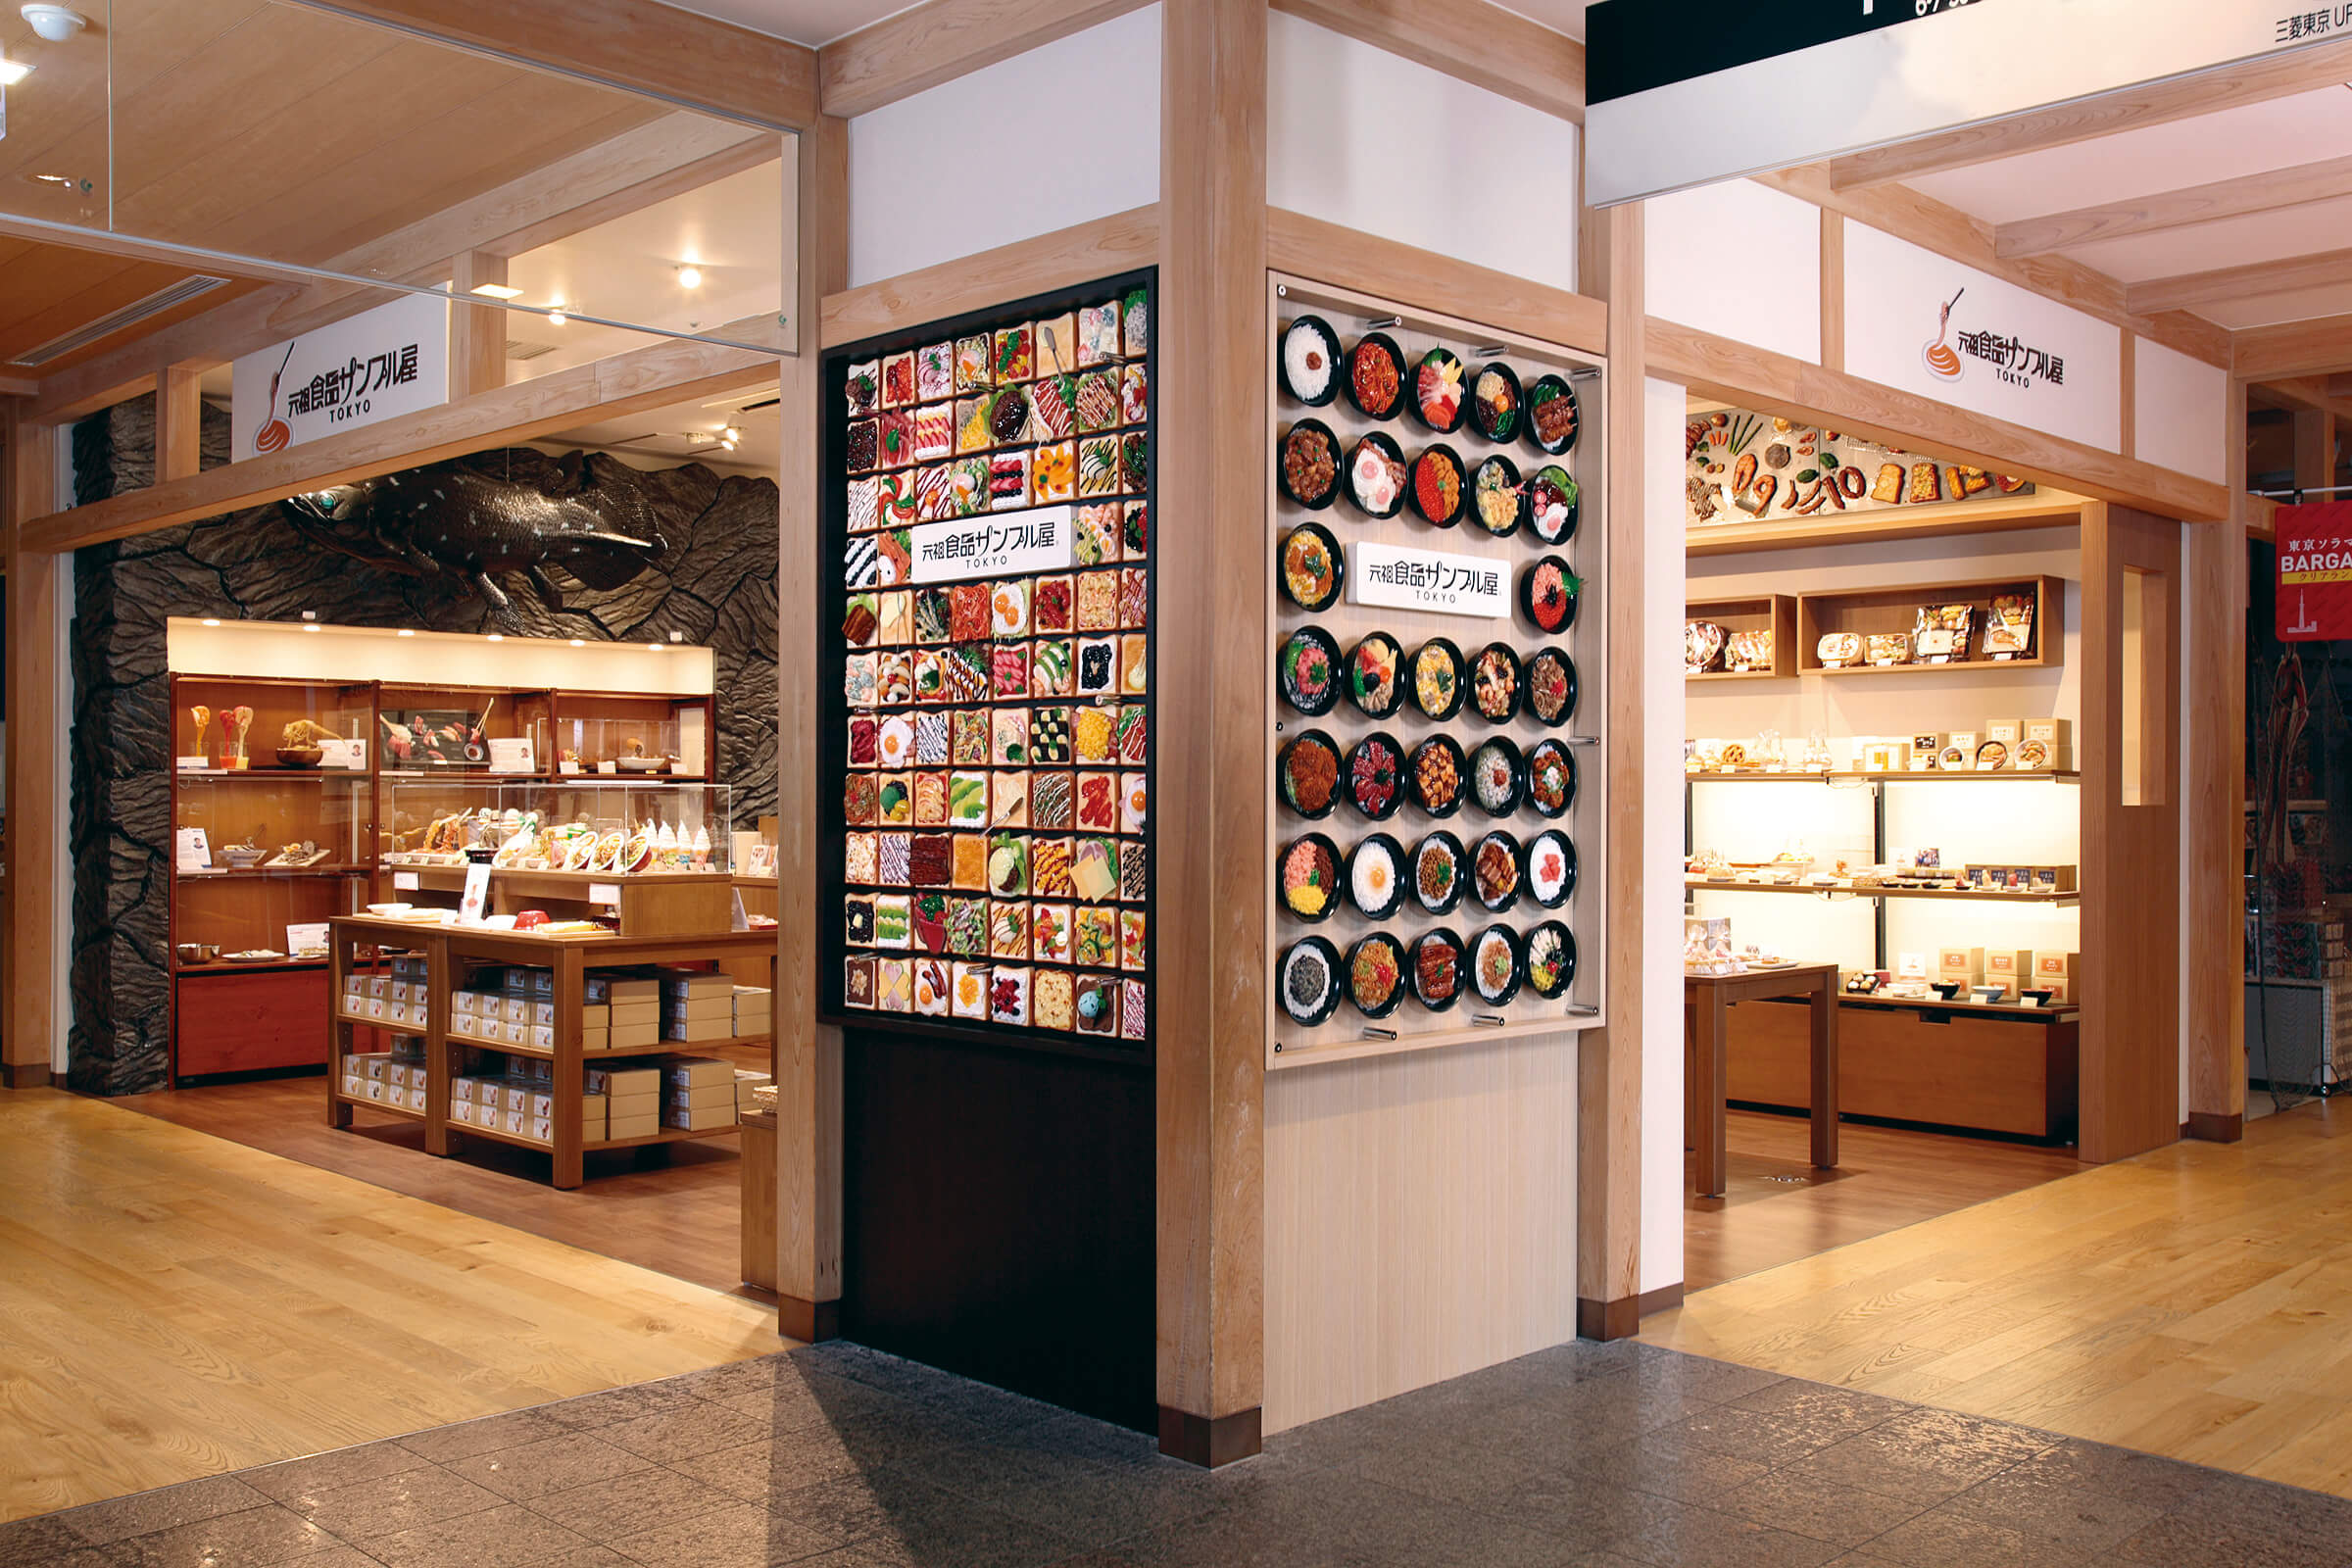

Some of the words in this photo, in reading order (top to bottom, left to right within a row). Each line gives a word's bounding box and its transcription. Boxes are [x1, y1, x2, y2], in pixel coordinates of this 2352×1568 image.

[2275, 9, 2330, 42] 三菱東京
[1958, 330, 2063, 385] 元祖食品サンプル屋
[288, 344, 417, 417] 元祖食品サンプル屋
[1996, 368, 2030, 388] TOKYO
[329, 399, 370, 423] TOKYO
[922, 521, 1055, 562] 元祖食品サンプル屋
[966, 555, 1007, 568] TOKYO
[1369, 560, 1497, 596] 元祖食品サンプル屋
[1416, 590, 1456, 604] TOKYO
